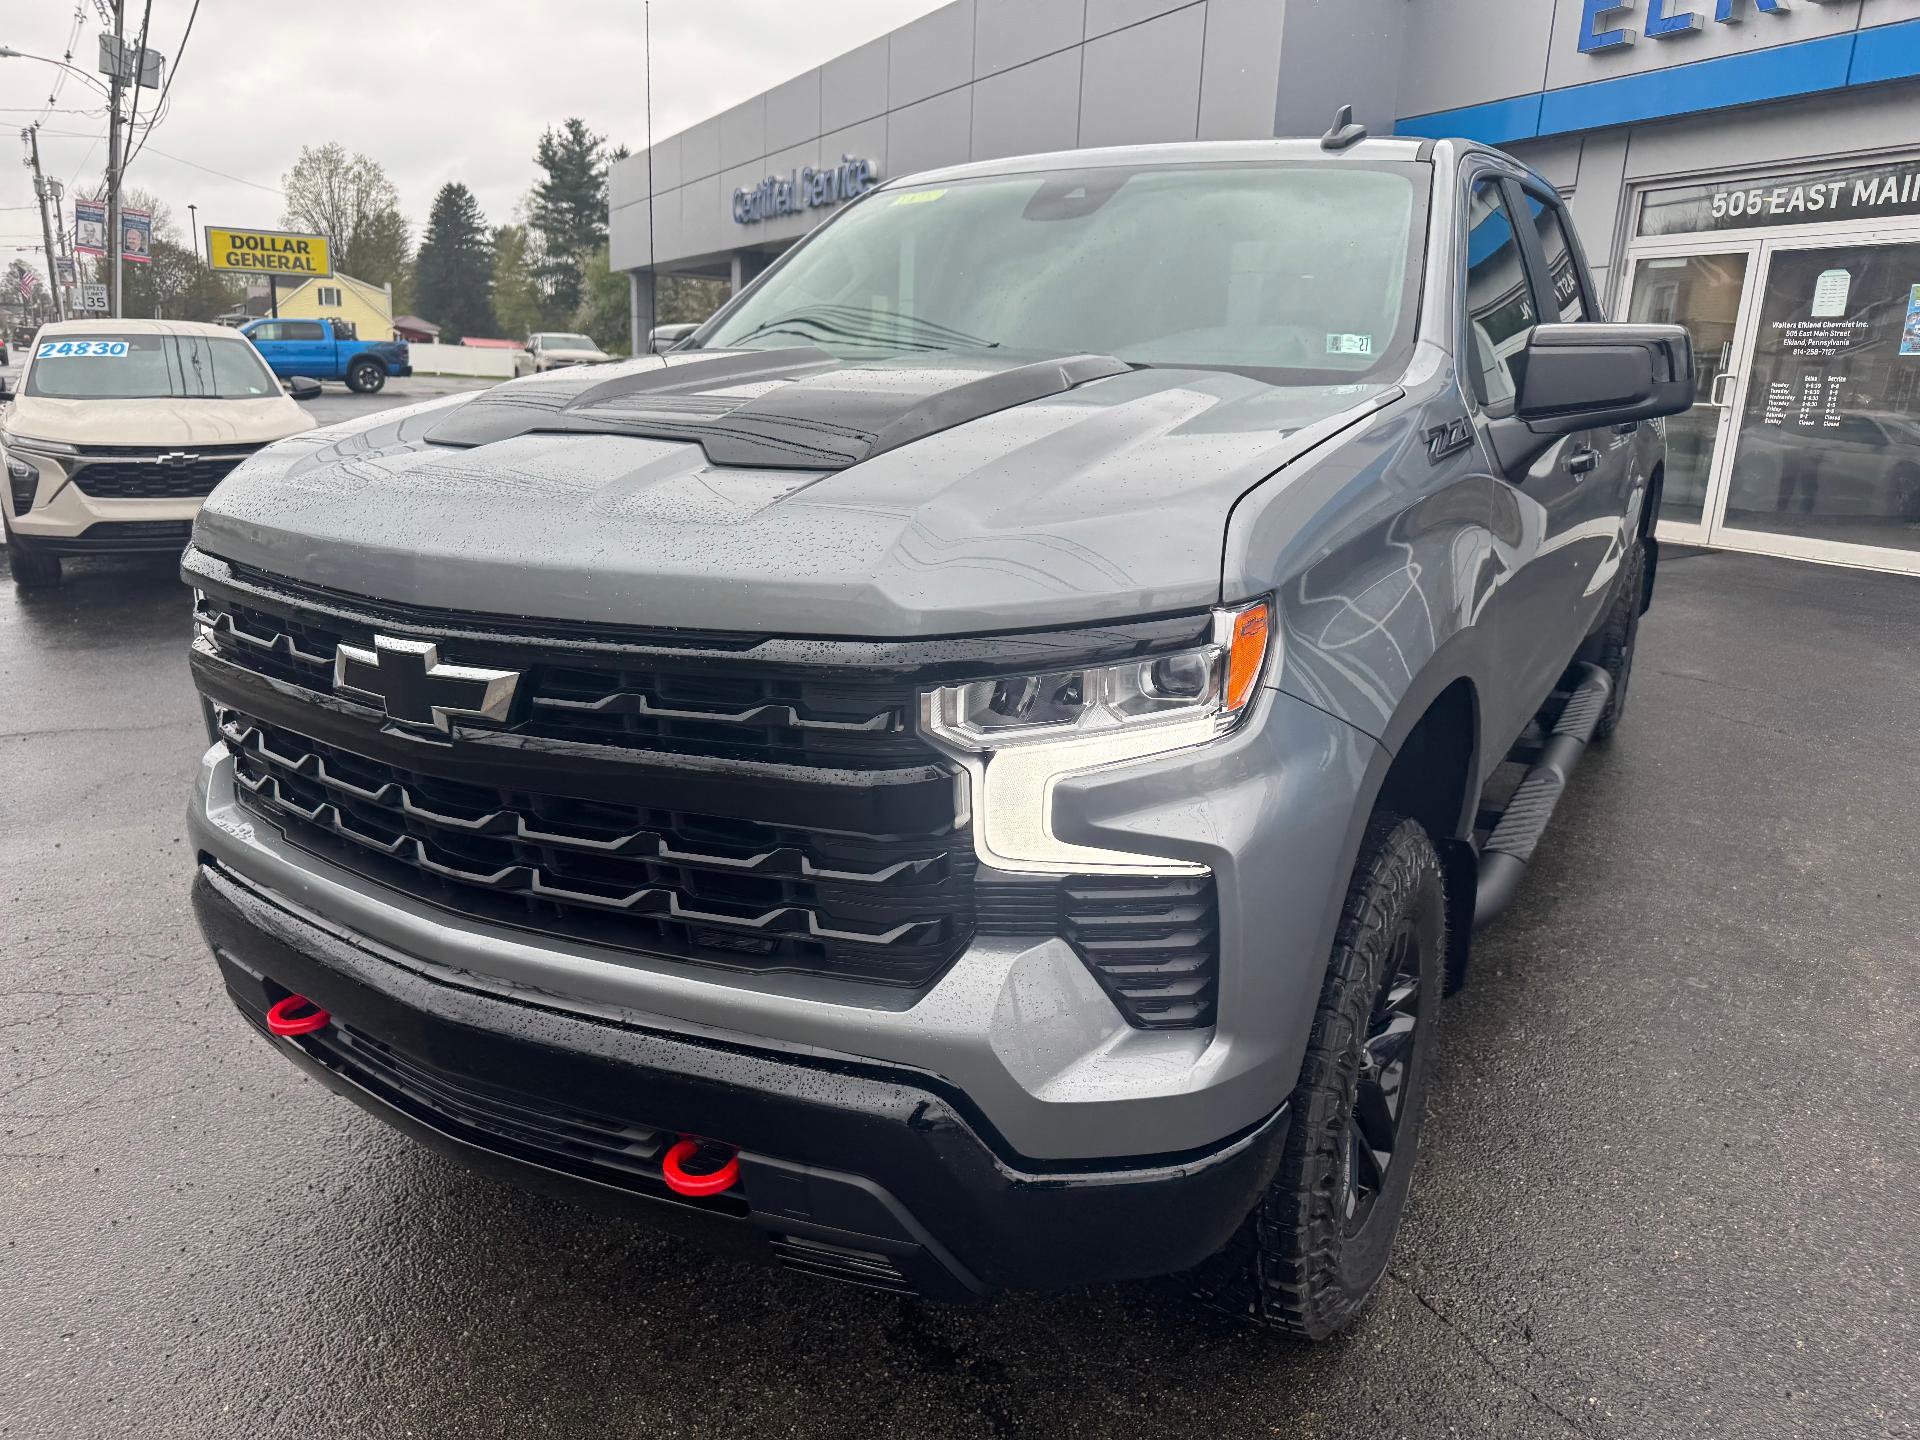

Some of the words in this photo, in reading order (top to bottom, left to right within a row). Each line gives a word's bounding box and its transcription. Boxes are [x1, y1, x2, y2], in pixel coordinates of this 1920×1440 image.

[733, 169, 800, 224] Certified
[802, 154, 873, 207] Service
[1711, 190, 1763, 218] 505
[1769, 182, 1847, 214] EAST
[229, 235, 310, 255] DOLLAR
[226, 251, 317, 271] GENERAL
[87, 297, 106, 308] 35
[1772, 321, 1796, 329] Walters
[1798, 321, 1821, 329] Elkland
[1823, 320, 1855, 328] Chevrolet
[1856, 320, 1869, 328] Inc.
[38, 342, 126, 357] 24830
[1359, 337, 1369, 351] 27
[1783, 339, 1807, 347] Elkland,
[1807, 339, 1850, 347] Pennsylvania
